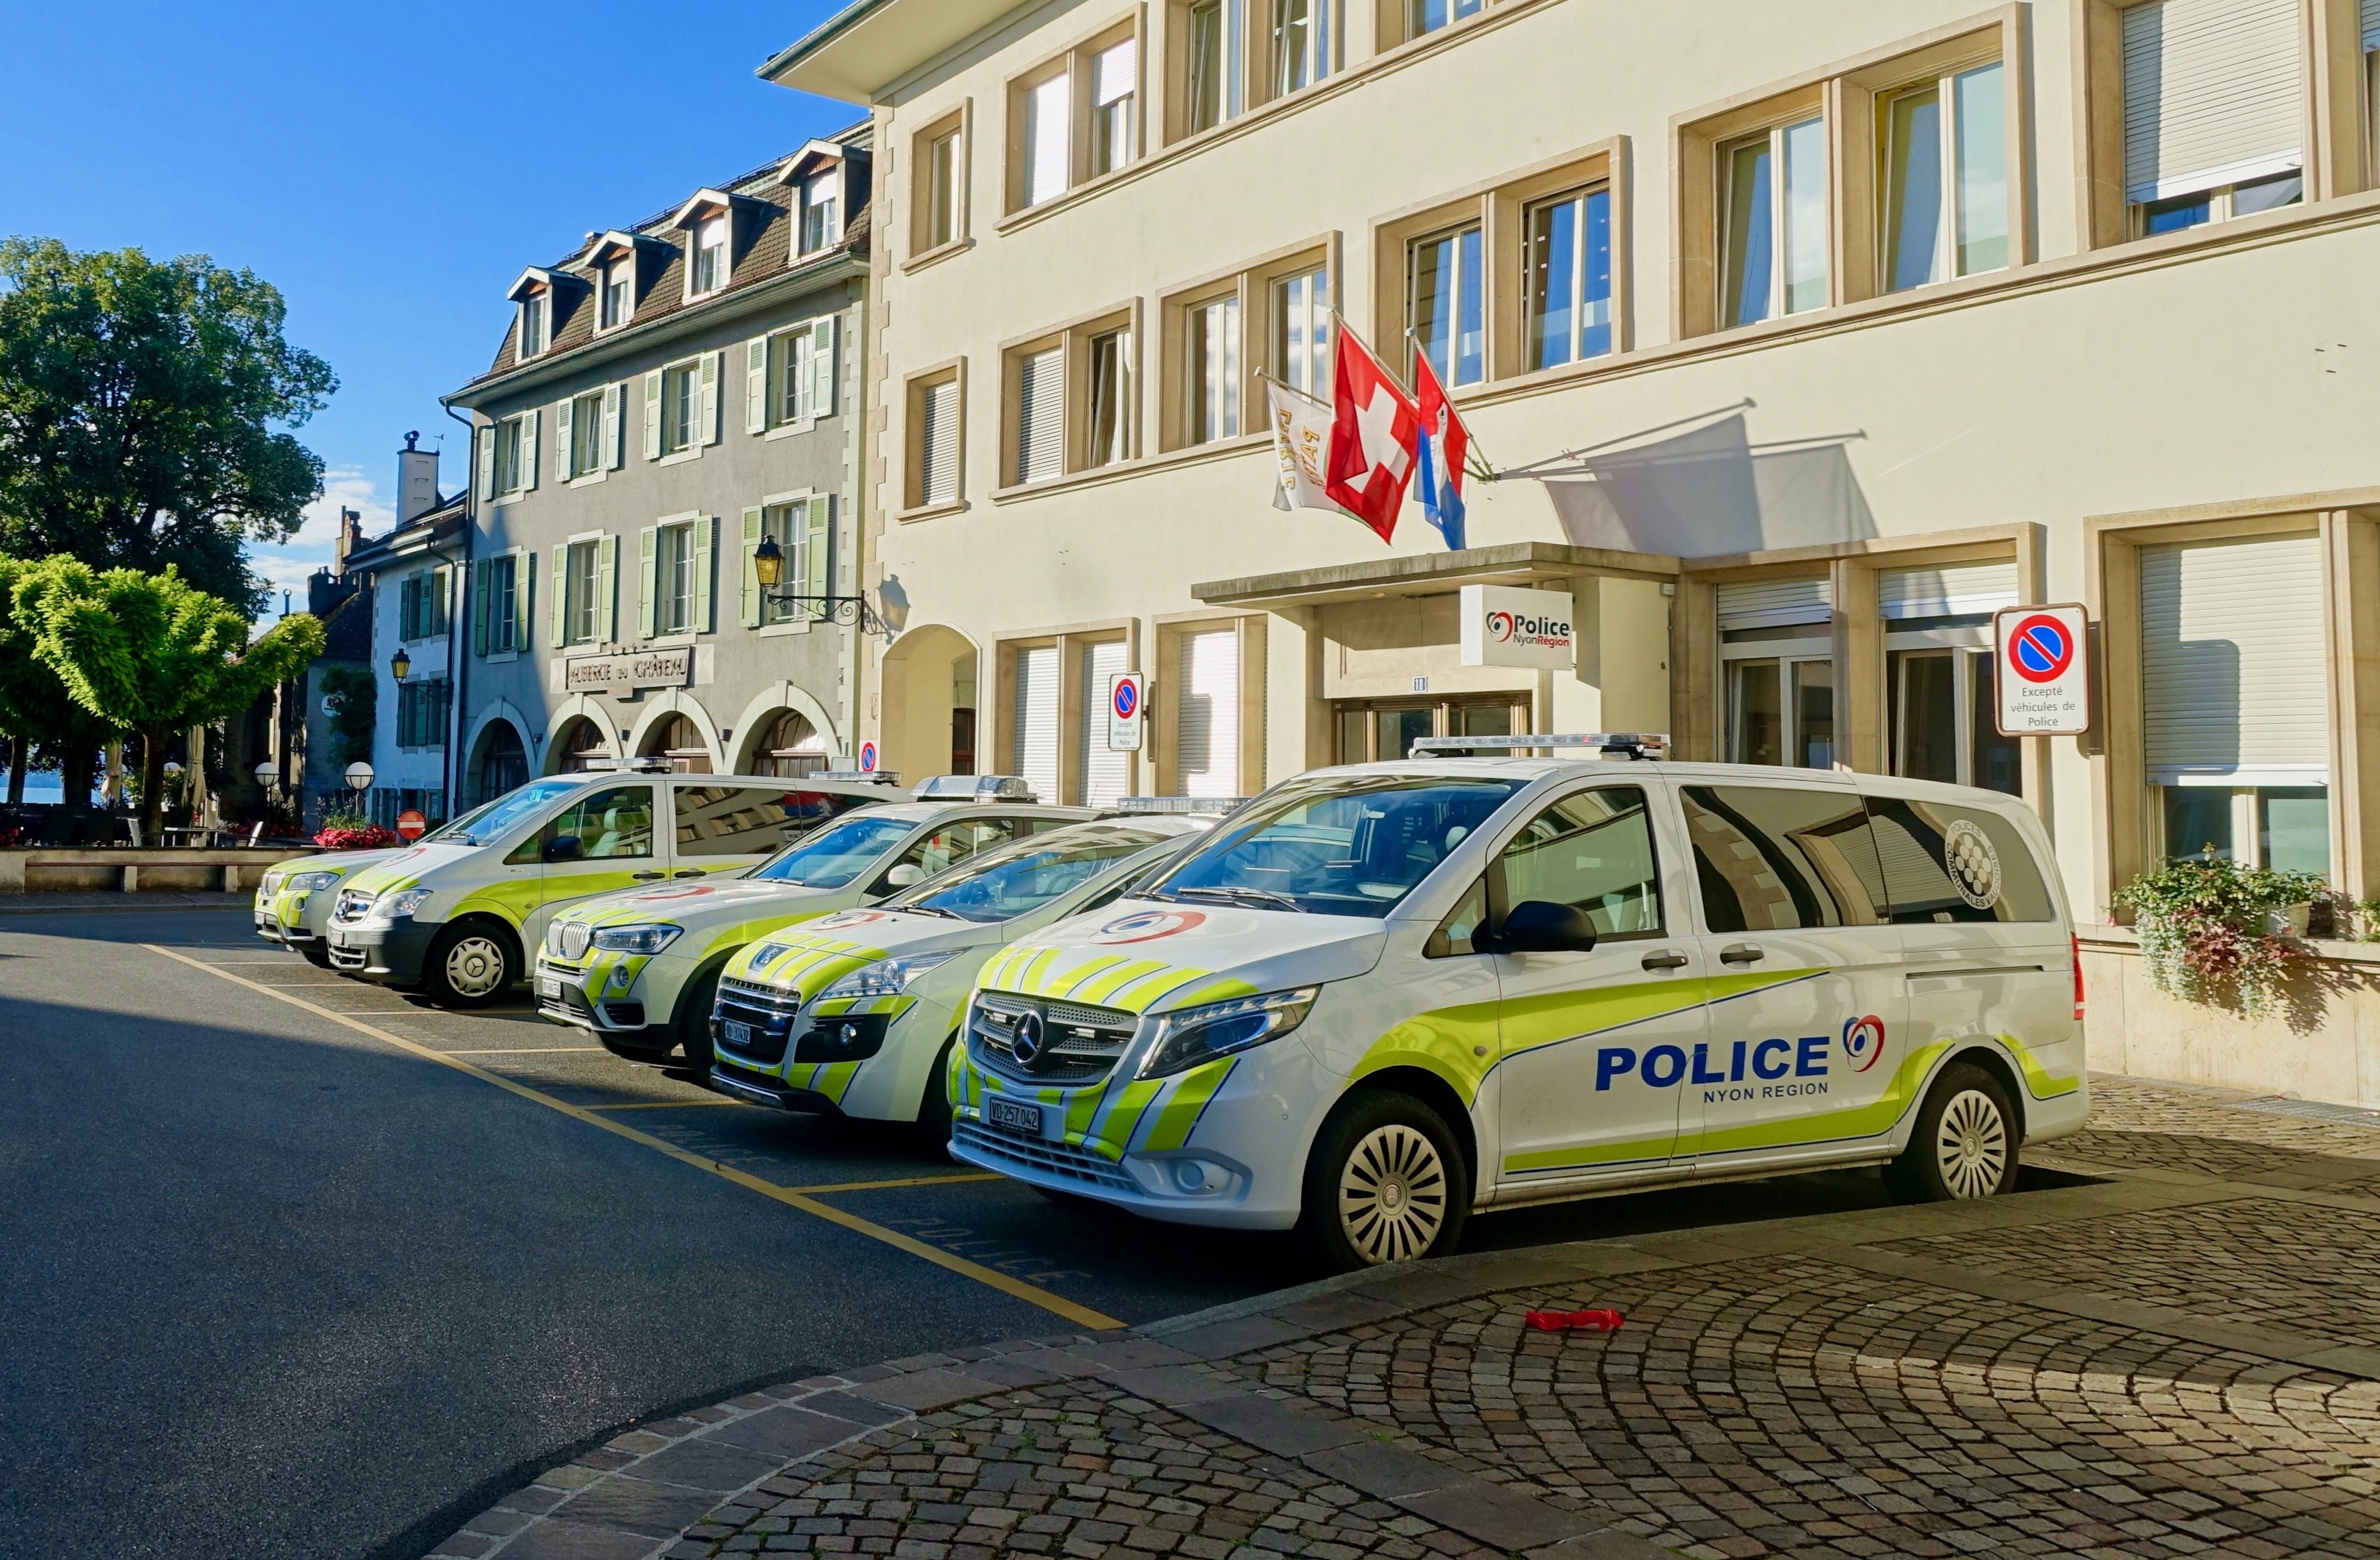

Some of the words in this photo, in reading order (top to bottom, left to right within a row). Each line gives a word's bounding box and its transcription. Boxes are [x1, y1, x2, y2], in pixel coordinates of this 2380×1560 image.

[1514, 615, 1569, 636] Police
[1513, 633, 1569, 648] NyonRégion
[1415, 678, 1423, 690] 10
[2022, 686, 2062, 698] Excepté
[2010, 702, 2058, 712] véhicules
[2062, 701, 2075, 711] de
[2028, 716, 2059, 726] Police
[1951, 822, 1981, 837] POLICES
[1947, 843, 1985, 907] COMMUNALES
[1595, 1036, 1831, 1092] POLICE
[1704, 1088, 1754, 1103] NYON
[1762, 1082, 1829, 1098] REGION
[1021, 1108, 1037, 1127] 042
